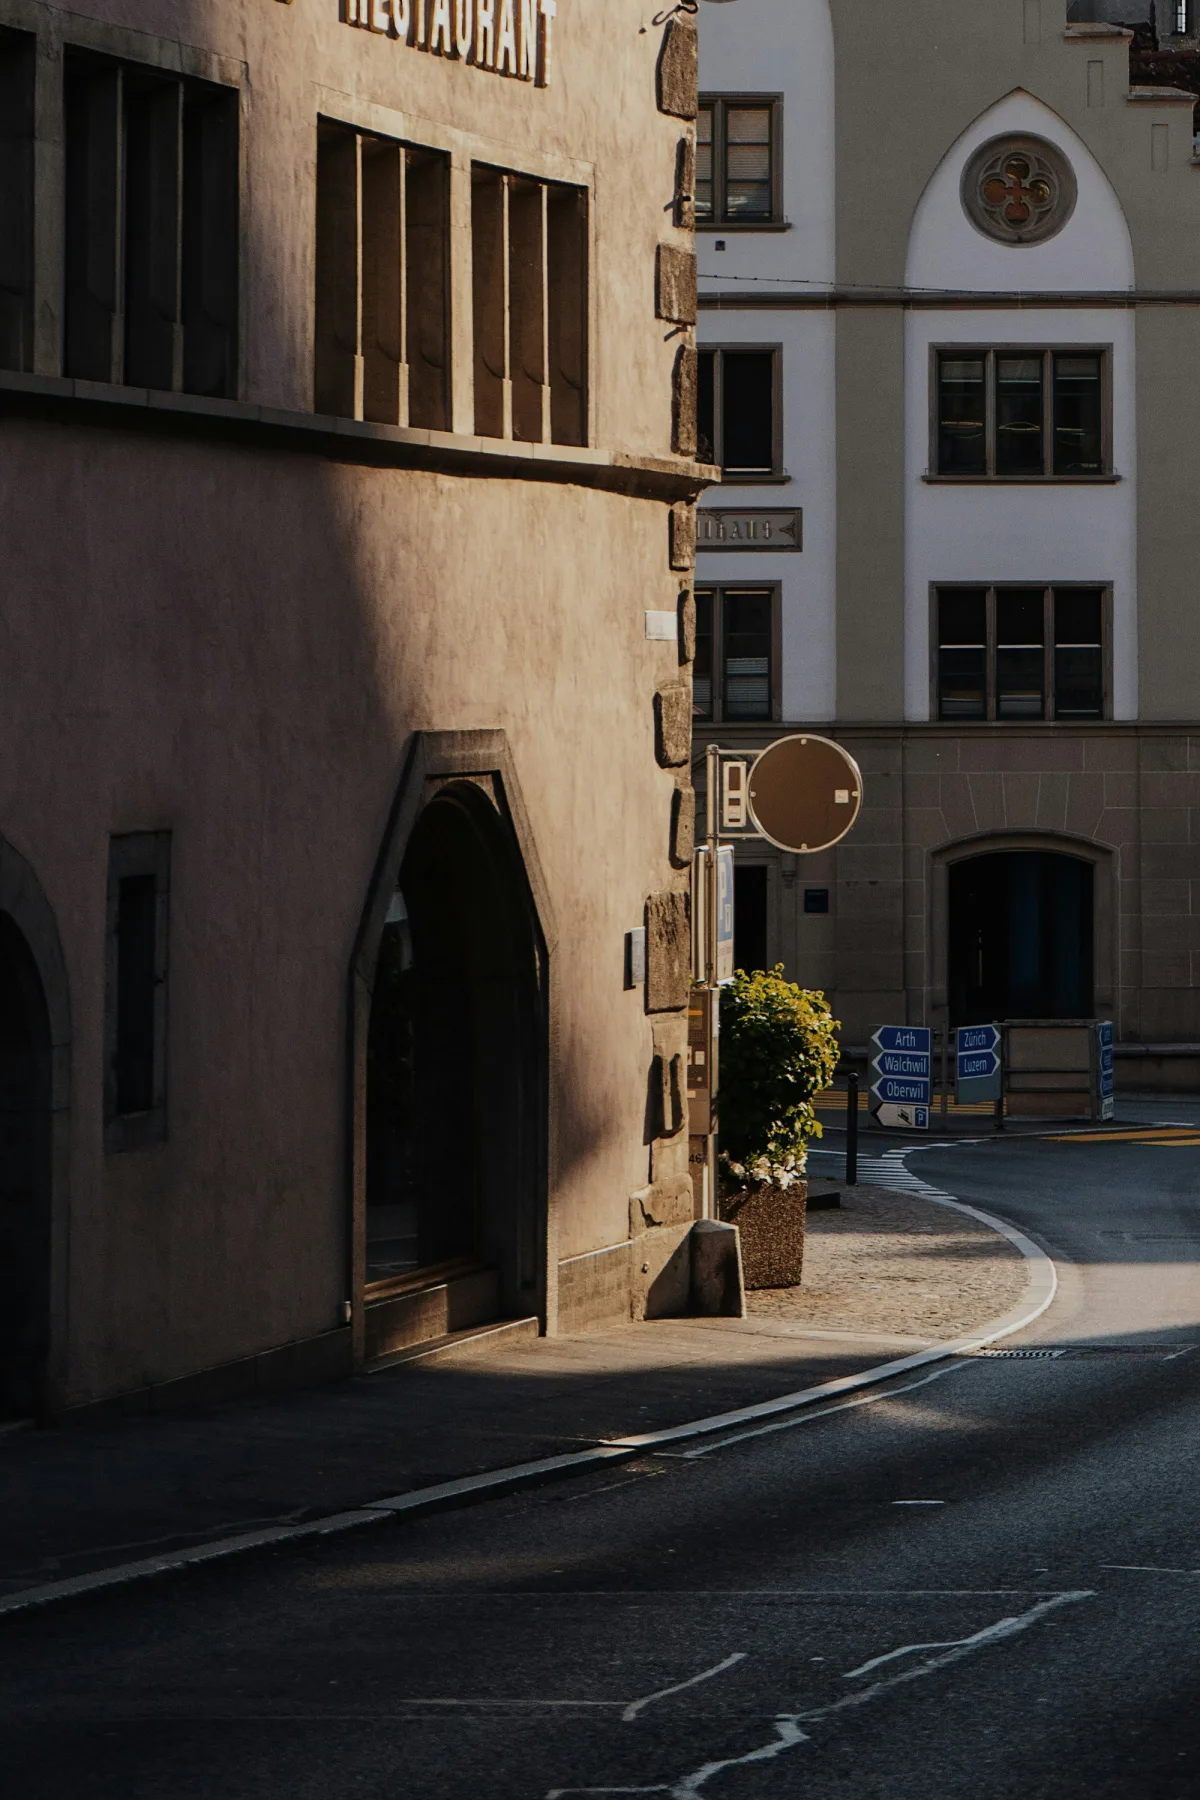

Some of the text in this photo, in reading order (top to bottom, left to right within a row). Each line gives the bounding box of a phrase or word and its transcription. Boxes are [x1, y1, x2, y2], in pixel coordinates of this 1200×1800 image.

[895, 1031, 916, 1047] Arth
[964, 1031, 987, 1047] Zürich
[884, 1056, 926, 1073] Walchwil
[964, 1059, 987, 1073] Luzern
[886, 1081, 924, 1099] Oberwil
[689, 1154, 702, 1164] 46
